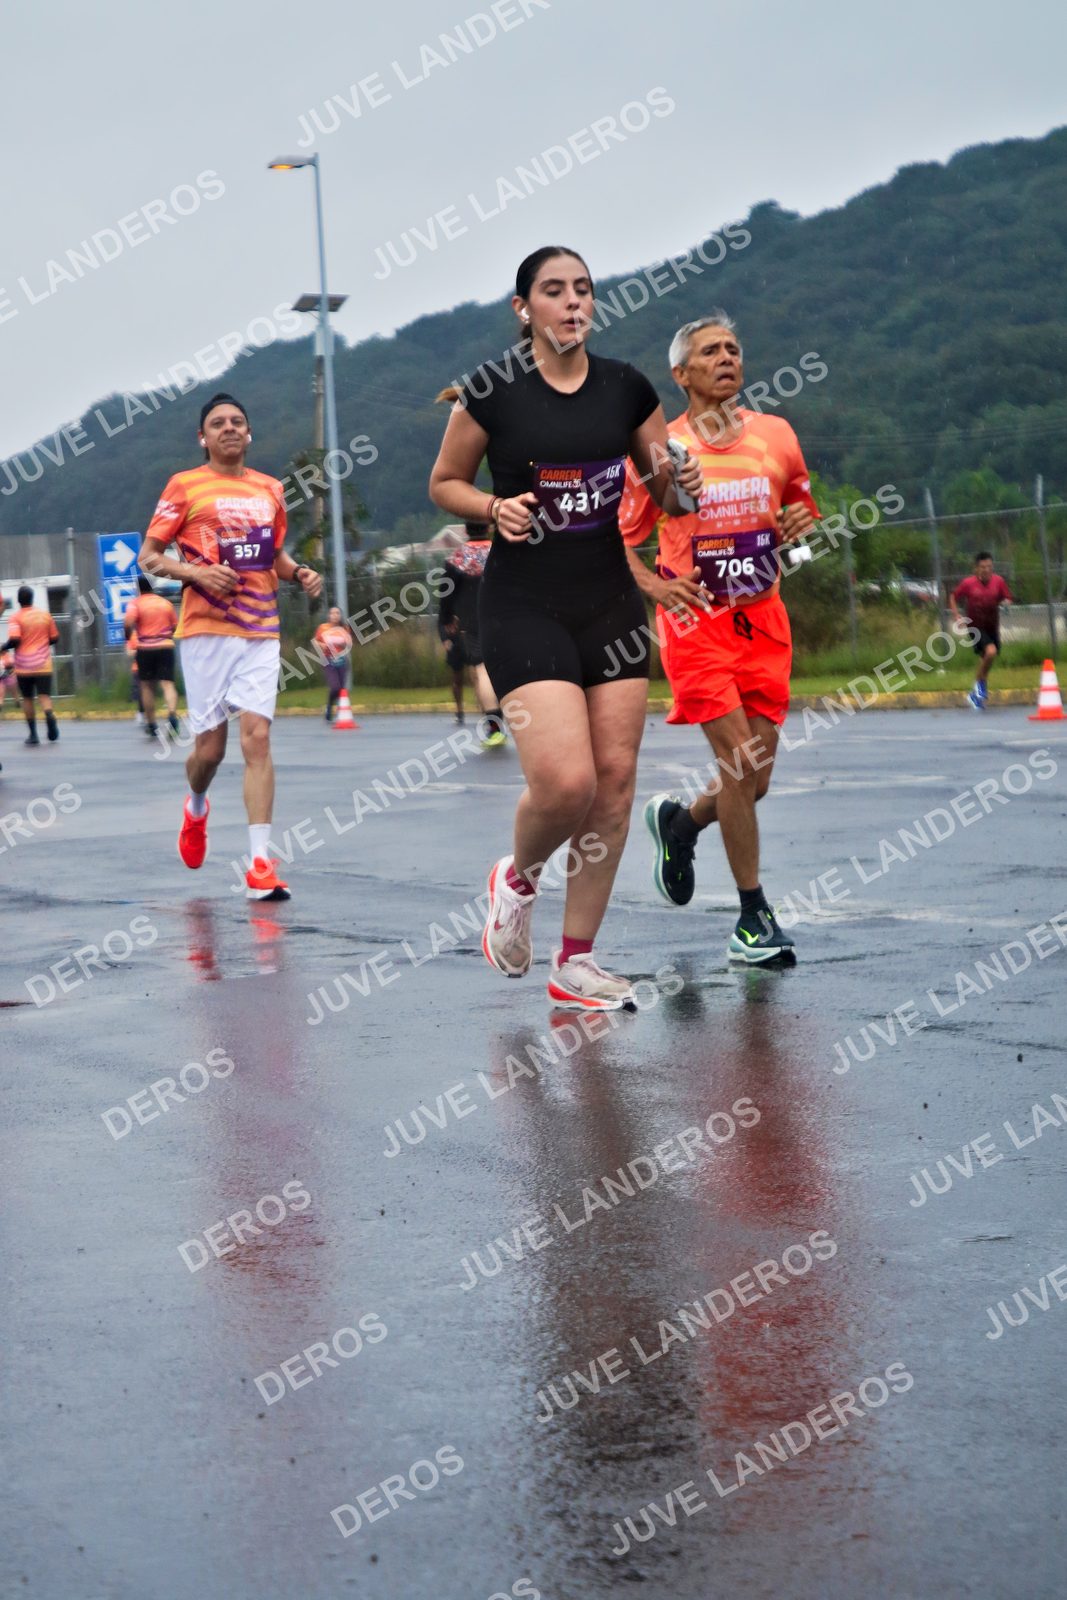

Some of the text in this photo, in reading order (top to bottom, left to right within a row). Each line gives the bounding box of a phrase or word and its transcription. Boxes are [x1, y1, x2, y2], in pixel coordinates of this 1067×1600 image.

[540, 469, 582, 481] CARRERA
[559, 491, 600, 512] 431
[698, 477, 772, 507] CARRERA
[698, 500, 757, 521] OMNILIFE
[234, 543, 261, 559] 357
[697, 538, 735, 551] CARRERA
[715, 556, 755, 579] 706
